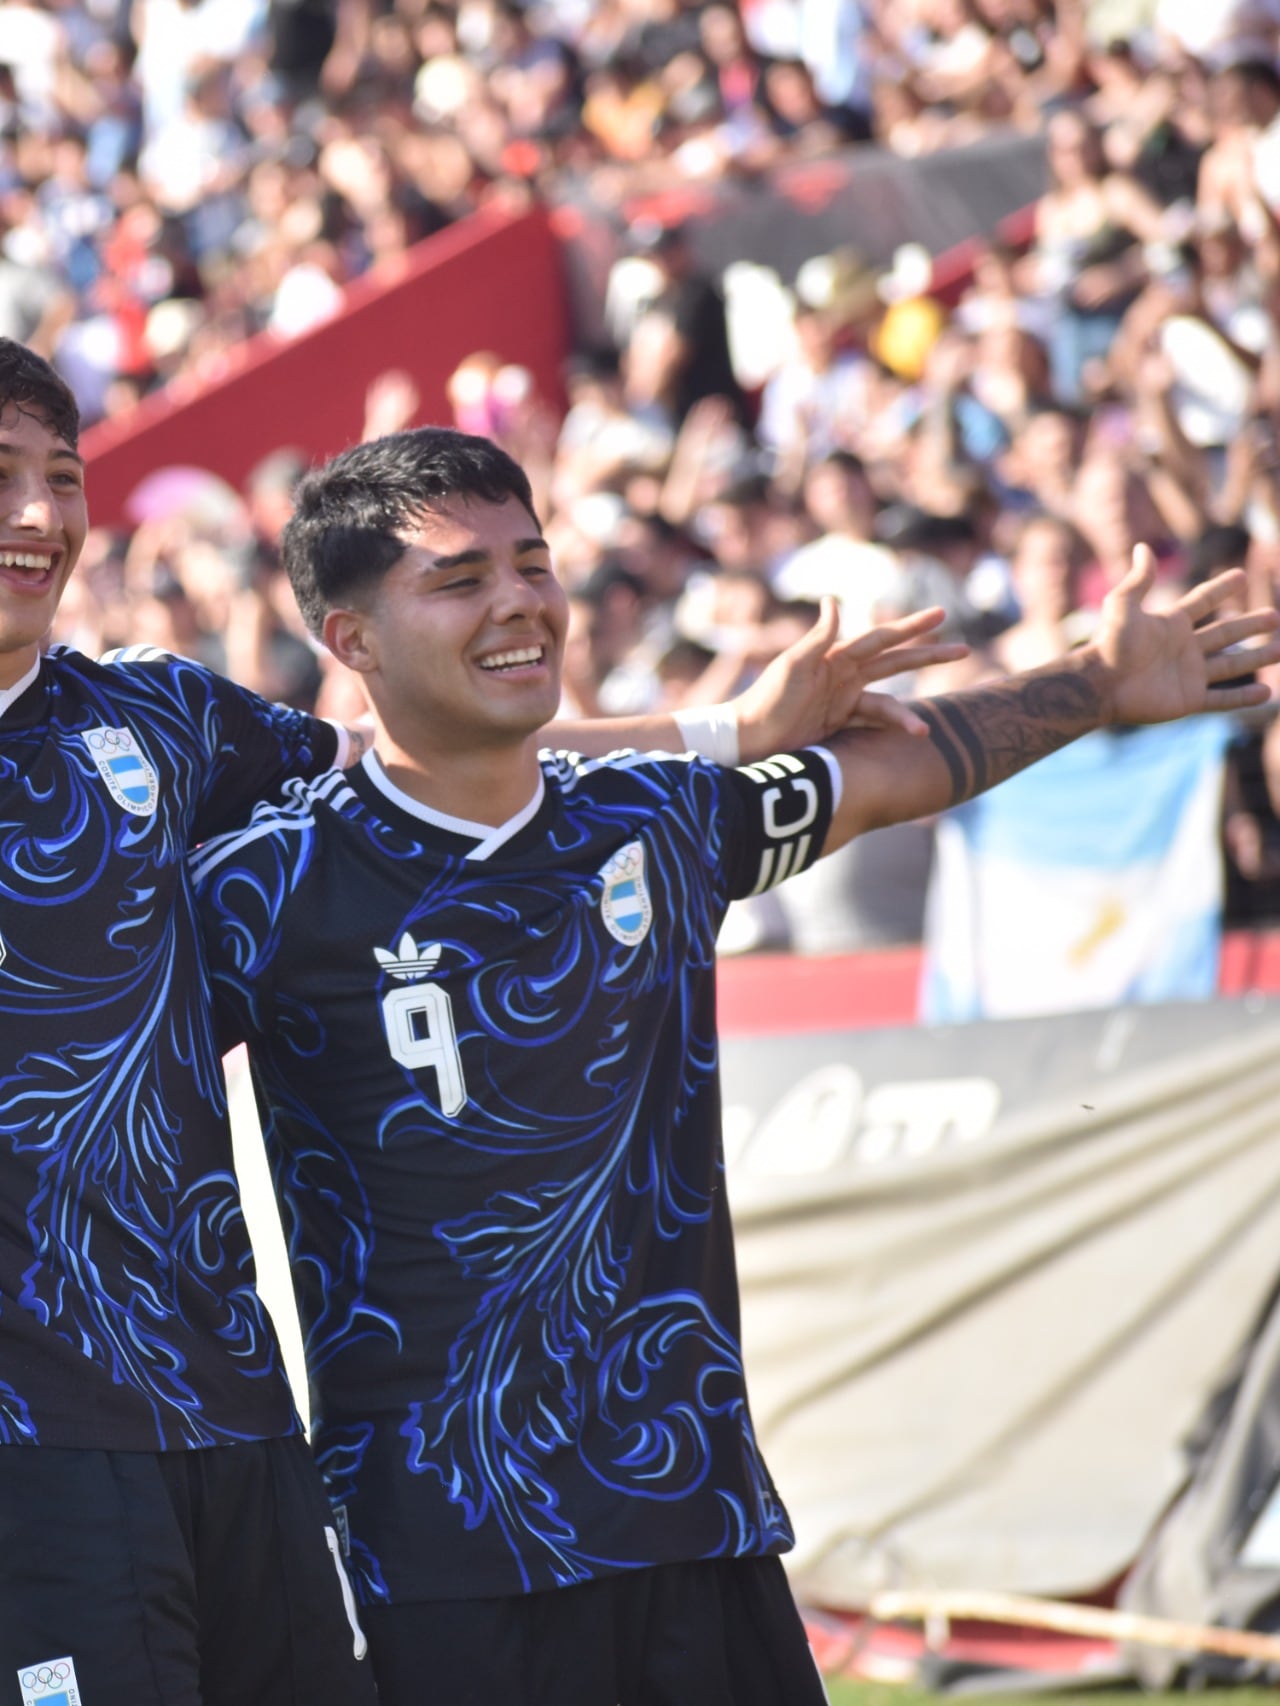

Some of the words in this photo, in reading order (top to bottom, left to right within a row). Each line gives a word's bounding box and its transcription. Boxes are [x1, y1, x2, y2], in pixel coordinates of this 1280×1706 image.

[98, 760, 118, 790] COMITE
[762, 778, 818, 839] C
[382, 982, 467, 1118] 9
